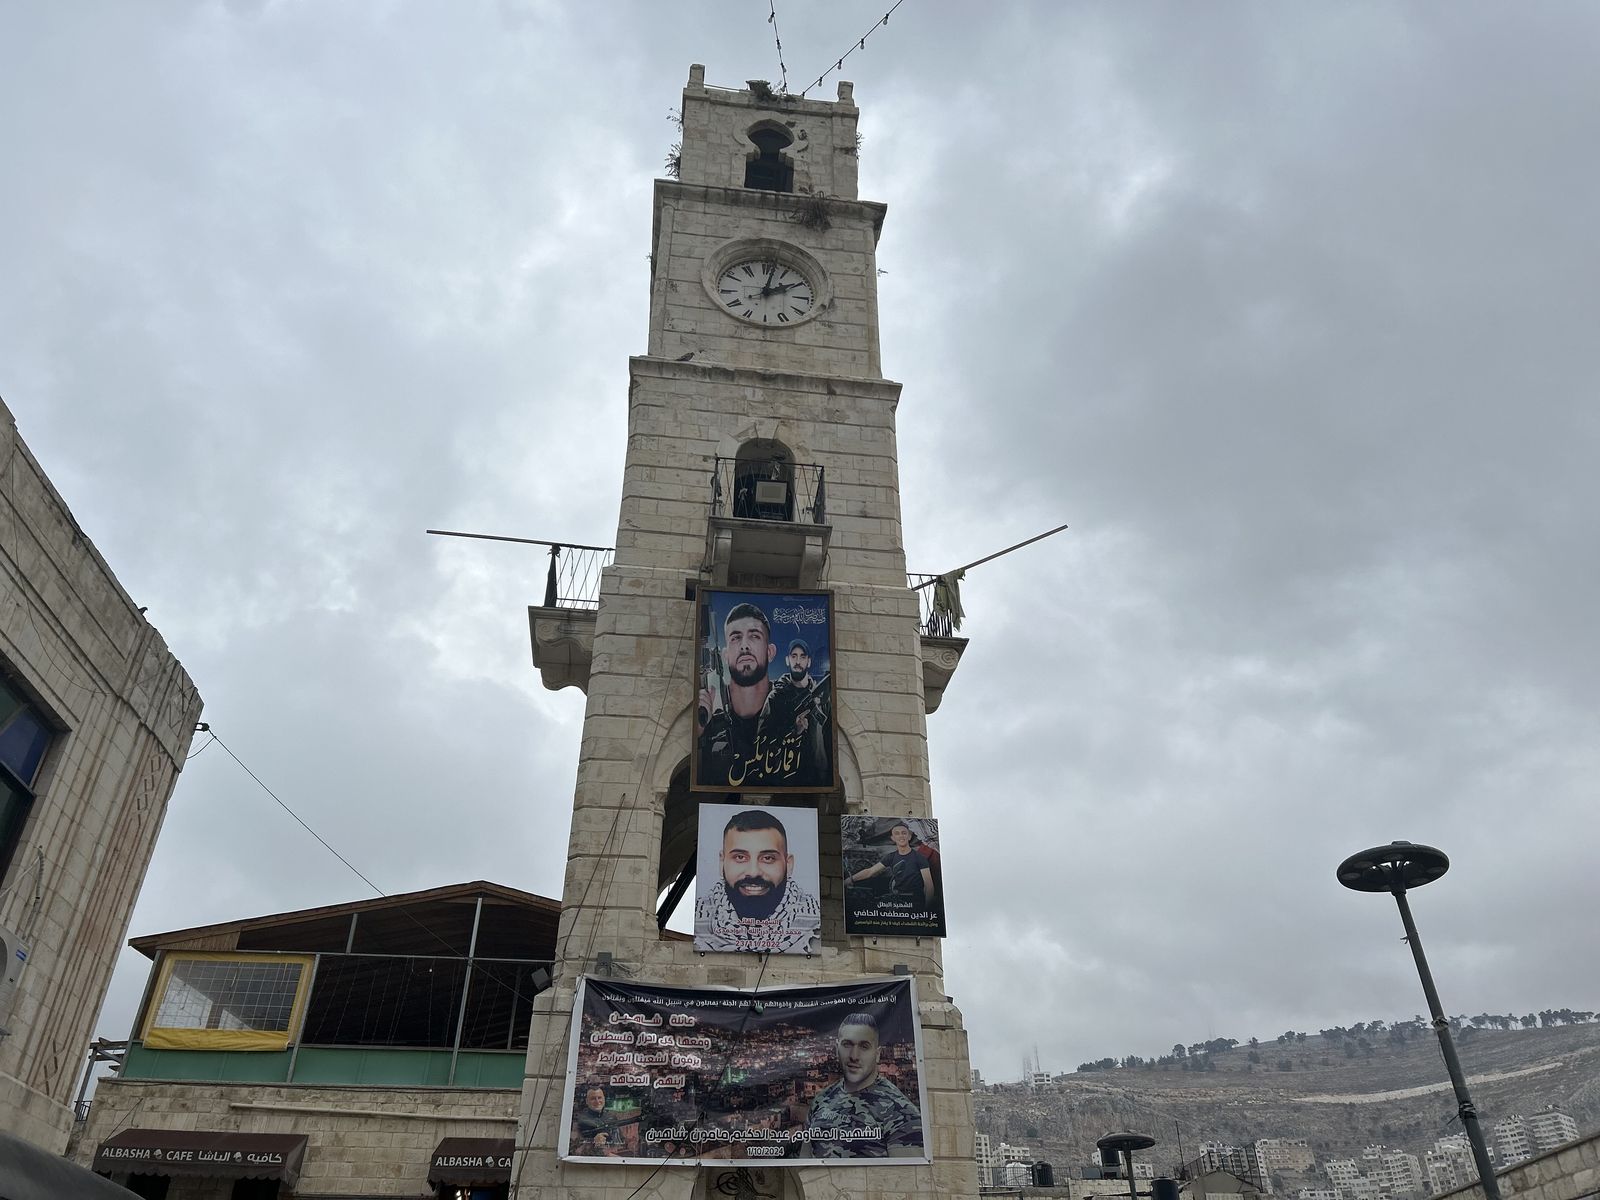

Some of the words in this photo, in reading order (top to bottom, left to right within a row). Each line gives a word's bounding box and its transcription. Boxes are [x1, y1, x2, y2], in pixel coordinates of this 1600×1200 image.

[893, 901, 913, 909] الشهيد
[853, 909, 879, 918] الحافي
[880, 910, 910, 918] مصطفى
[910, 911, 929, 920] الدين
[929, 912, 938, 920] عز
[735, 940, 781, 948] 23/11/2022
[652, 995, 664, 1005] الله
[665, 998, 682, 1008] سبيل
[684, 999, 695, 1008] في
[877, 994, 889, 1003] الله
[591, 1030, 634, 1044] فلسطين
[658, 1035, 675, 1046] كل
[676, 1035, 711, 1050] ومعها
[597, 1051, 633, 1066] المرابط
[634, 1052, 668, 1066] لشعبنا
[610, 1074, 650, 1087] المجاهد
[645, 1126, 688, 1143] شاهين
[729, 1127, 770, 1143] الحكيم
[791, 1127, 838, 1143] المقاوم
[840, 1126, 882, 1142] الشهيد
[101, 1147, 151, 1159] ALBASHA
[166, 1150, 194, 1161] CAFE
[197, 1150, 231, 1162] الباشا
[746, 1146, 785, 1157] 1/10/2024
[247, 1151, 282, 1165] كافيه
[435, 1156, 483, 1167] ALBASHA
